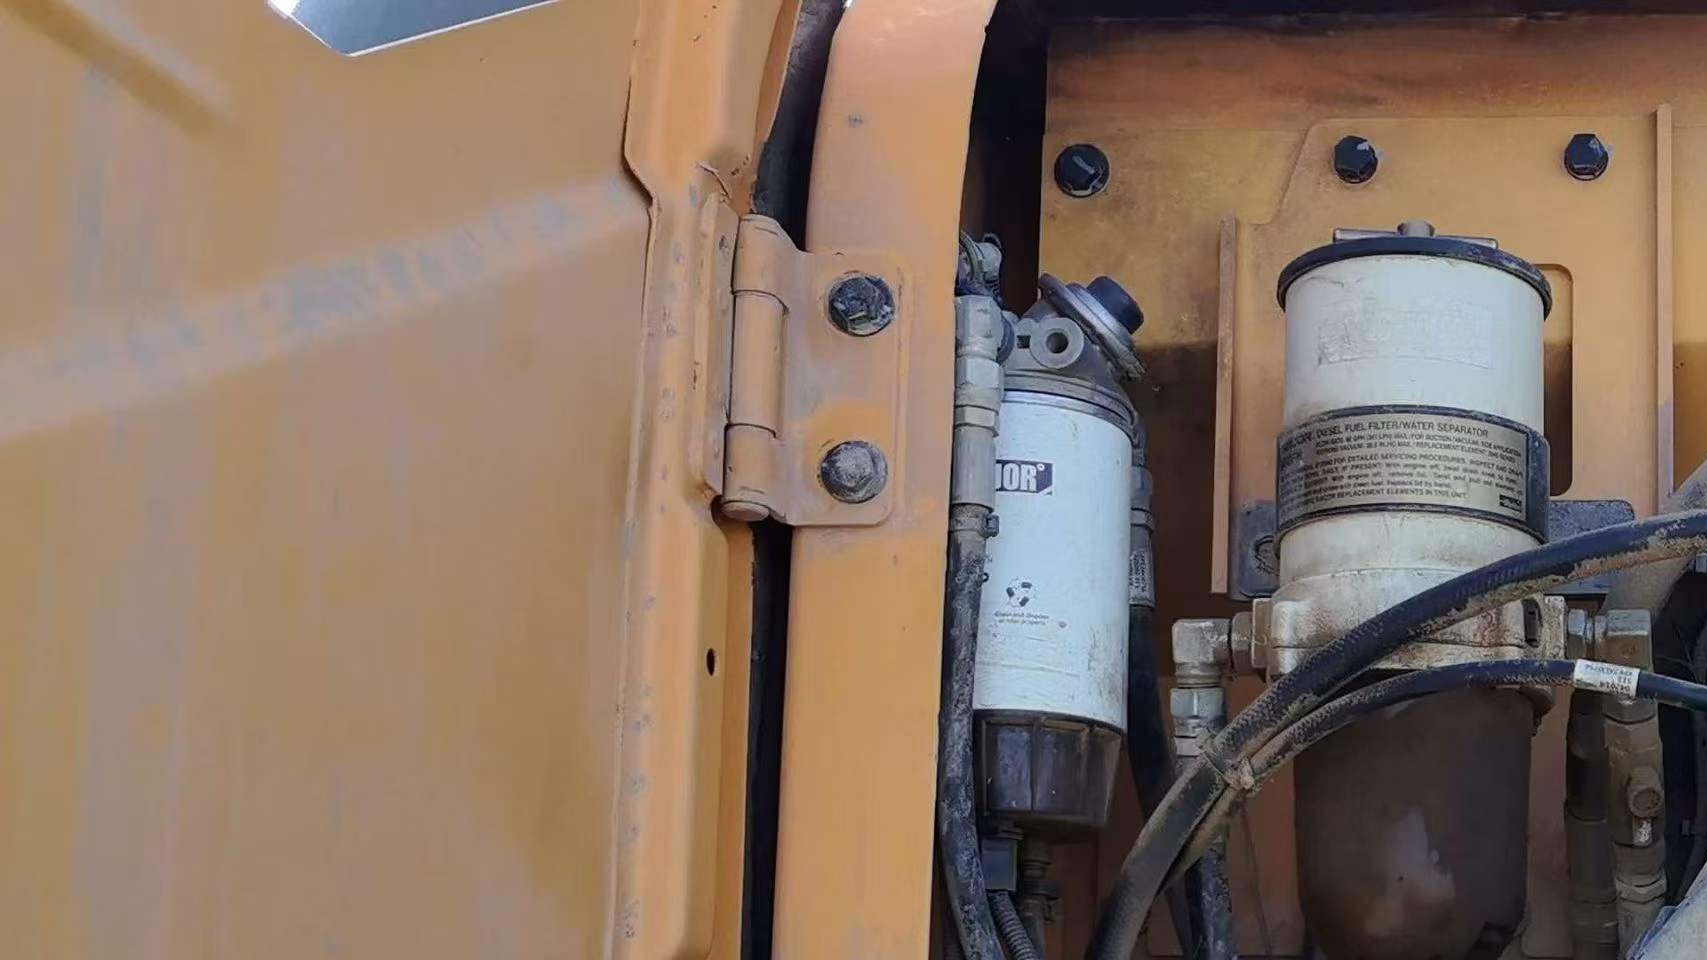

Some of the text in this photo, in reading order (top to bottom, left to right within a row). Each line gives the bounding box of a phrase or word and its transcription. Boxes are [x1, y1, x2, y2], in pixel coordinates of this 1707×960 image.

[1345, 422, 1367, 433] FUEL
[1368, 421, 1434, 431] FILTER/WATER
[1437, 423, 1489, 438] SEPARATOR
